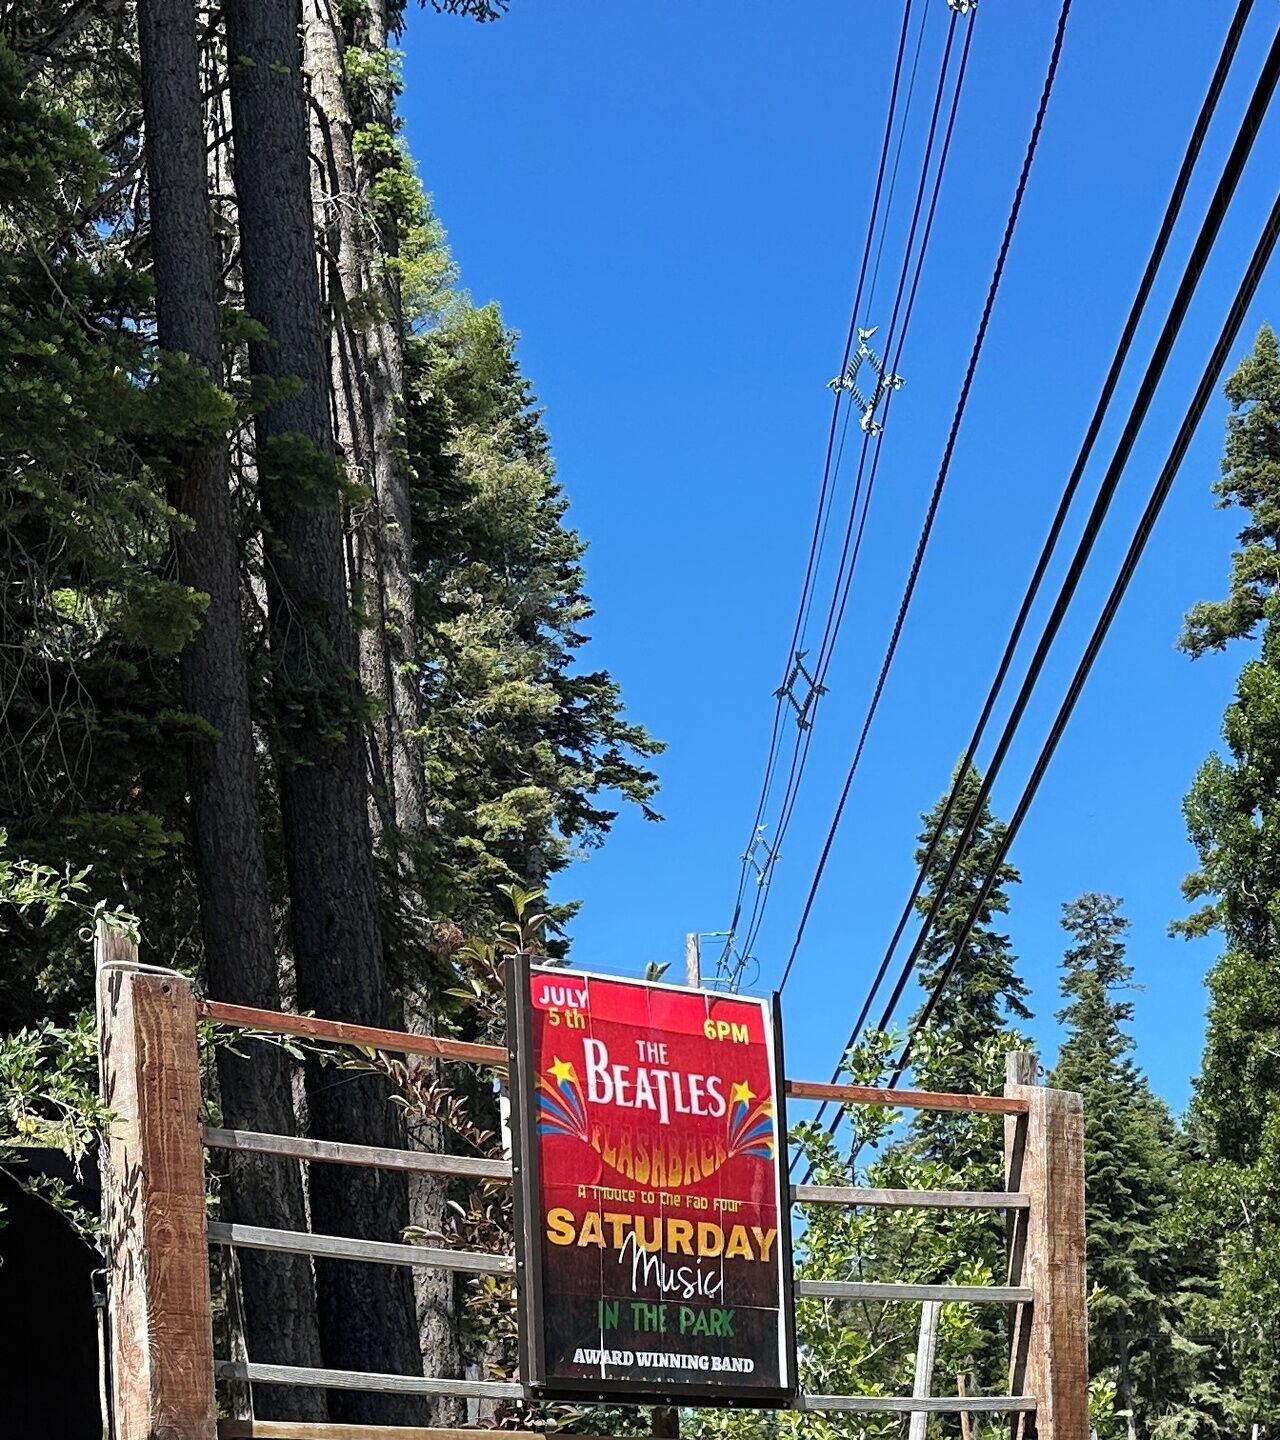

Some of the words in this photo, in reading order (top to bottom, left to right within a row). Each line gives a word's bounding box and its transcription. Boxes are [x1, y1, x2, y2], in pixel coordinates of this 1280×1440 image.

[539, 985, 587, 1009] JULY
[548, 1007, 561, 1027] 5
[565, 1008, 587, 1030] th
[703, 1018, 750, 1046] 6PM
[635, 1039, 670, 1066] THE
[582, 1037, 727, 1126] BEATLES
[591, 1121, 727, 1188] FLASHBACK
[577, 1184, 587, 1199] A
[641, 1189, 655, 1205] to
[660, 1191, 681, 1208] the
[686, 1194, 708, 1211] Fab
[713, 1197, 742, 1213] Four
[546, 1207, 778, 1263] SATURDAY
[618, 1230, 723, 1300] Music
[598, 1300, 620, 1331] IN
[631, 1302, 667, 1334] THE
[679, 1305, 737, 1338] PARK
[573, 1347, 634, 1367] AWARD
[636, 1351, 710, 1372] WINNING
[711, 1356, 756, 1374] BAND
